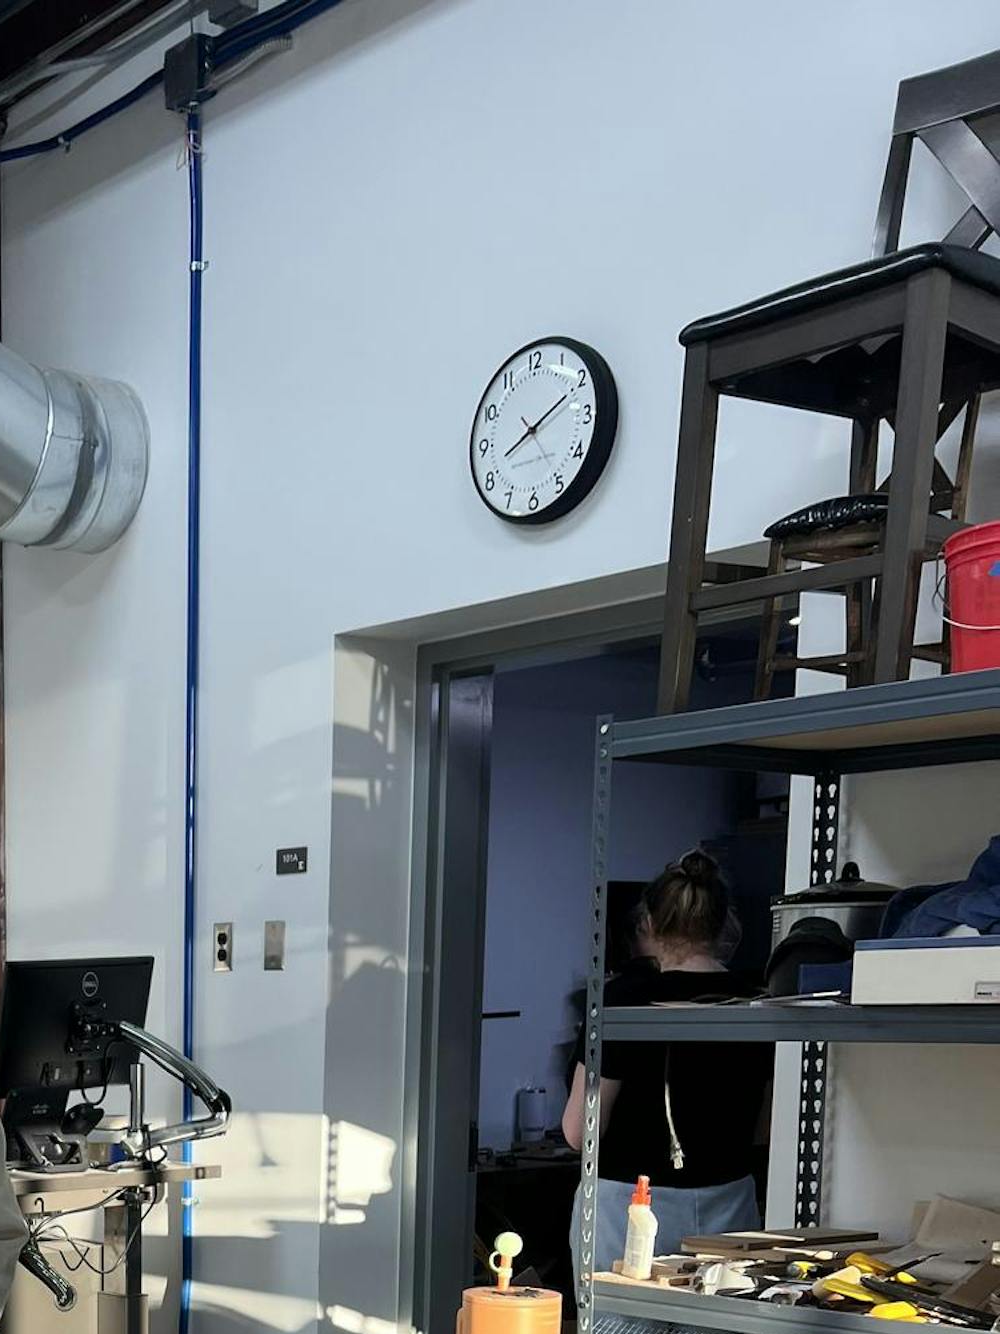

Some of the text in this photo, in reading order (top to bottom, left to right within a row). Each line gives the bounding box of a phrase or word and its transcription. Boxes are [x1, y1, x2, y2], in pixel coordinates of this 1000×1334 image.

[528, 351, 542, 371] 12
[560, 352, 564, 366] 1
[503, 371, 514, 389] 11
[577, 369, 586, 387] 2
[484, 404, 497, 423] 10
[582, 404, 592, 424] 3
[479, 439, 488, 458] 9
[572, 440, 584, 459] 4
[485, 471, 495, 490] 8
[555, 475, 564, 493] 5
[504, 492, 512, 509] 7
[528, 492, 539, 511] 6
